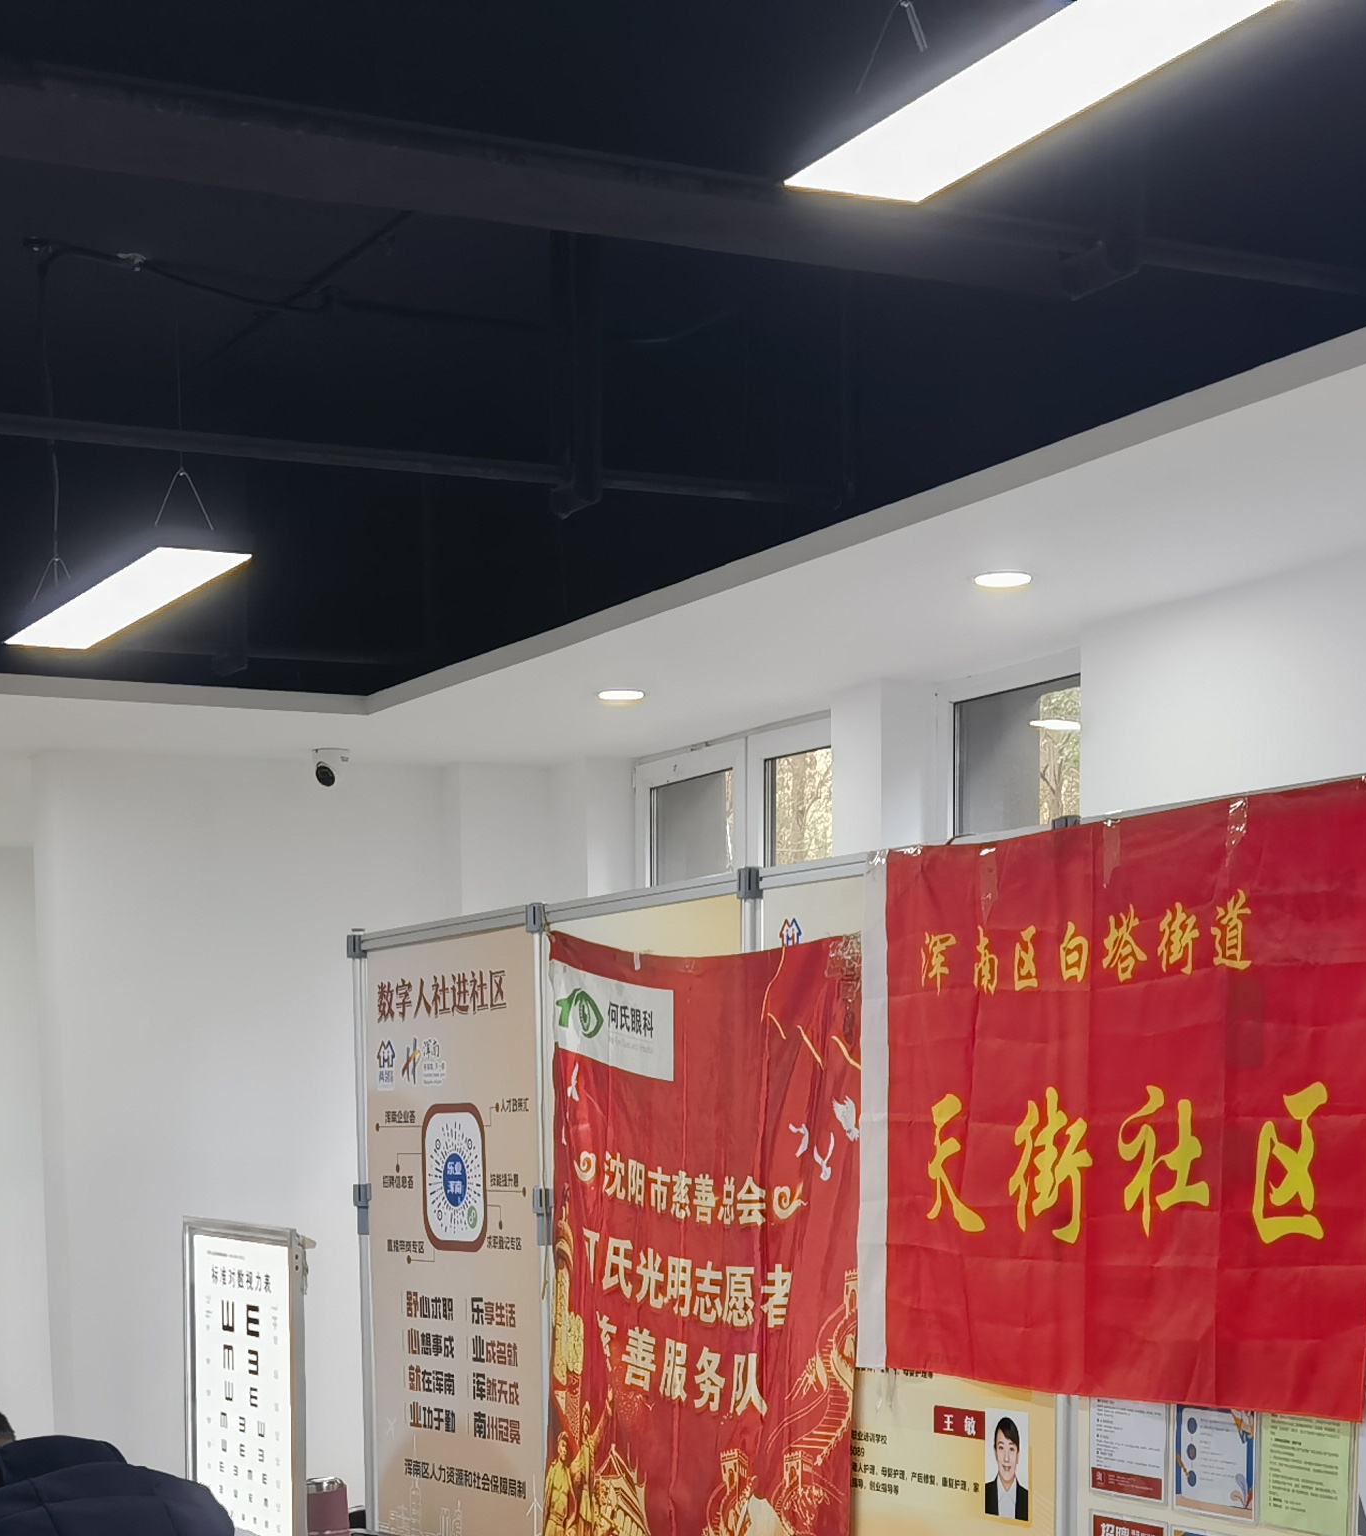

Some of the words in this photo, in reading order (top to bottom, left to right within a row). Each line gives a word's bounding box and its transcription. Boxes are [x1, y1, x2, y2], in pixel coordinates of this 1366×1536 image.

[921, 889, 1253, 995] 浑南区白塔街道
[377, 969, 507, 1023] 数字人社进社区
[607, 1002, 653, 1039] 何氏眼科
[926, 1081, 1329, 1245] 天街社区
[603, 1151, 767, 1226] 沈阳市慈善总会
[406, 1290, 453, 1321] 舒心求职
[471, 1297, 516, 1328] 乐享生活
[407, 1328, 454, 1359] 心想事成
[472, 1335, 518, 1367] 业成名就
[408, 1364, 455, 1396] 就在浑南
[472, 1373, 520, 1405] 浑然天成
[409, 1401, 455, 1433] 业功于勤
[404, 1458, 526, 1500] 浑南区人力资源和社会保障局制
